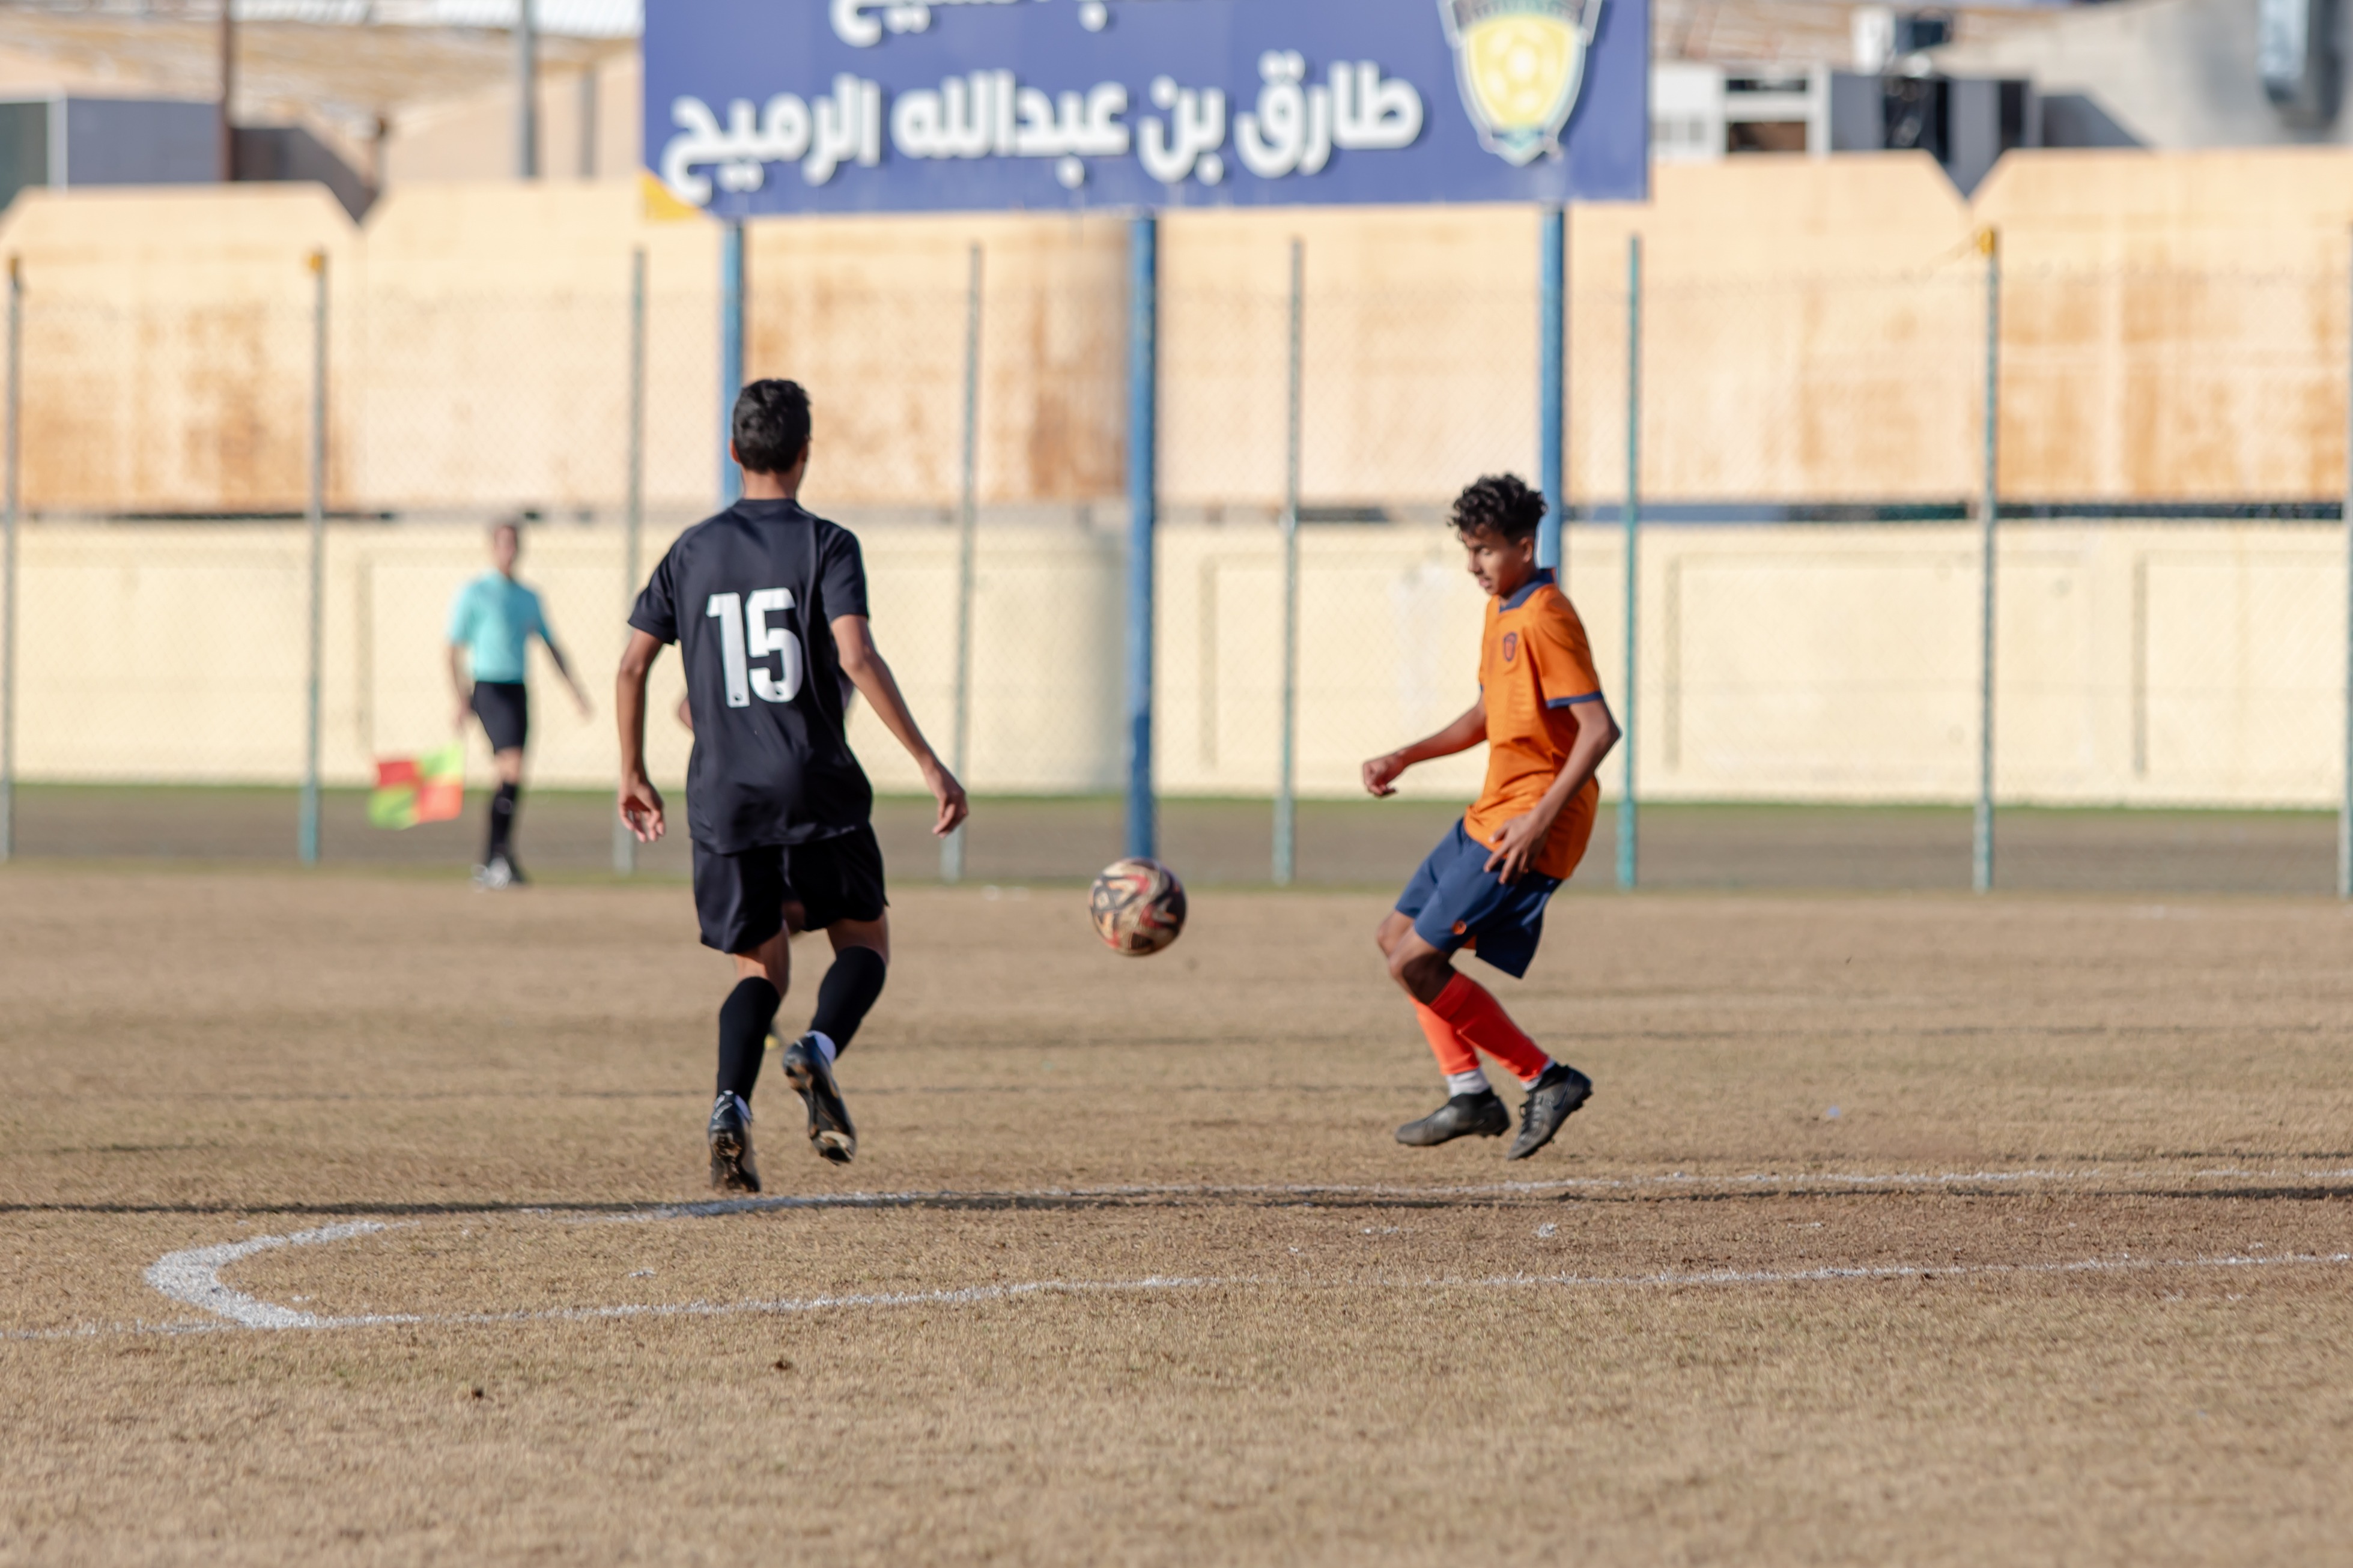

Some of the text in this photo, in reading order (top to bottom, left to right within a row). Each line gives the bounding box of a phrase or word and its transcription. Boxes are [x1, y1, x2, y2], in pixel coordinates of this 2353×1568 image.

[659, 73, 881, 207] الرميح
[1137, 76, 1225, 185] بن
[1234, 50, 1422, 179] طارق
[706, 587, 803, 708] 15
